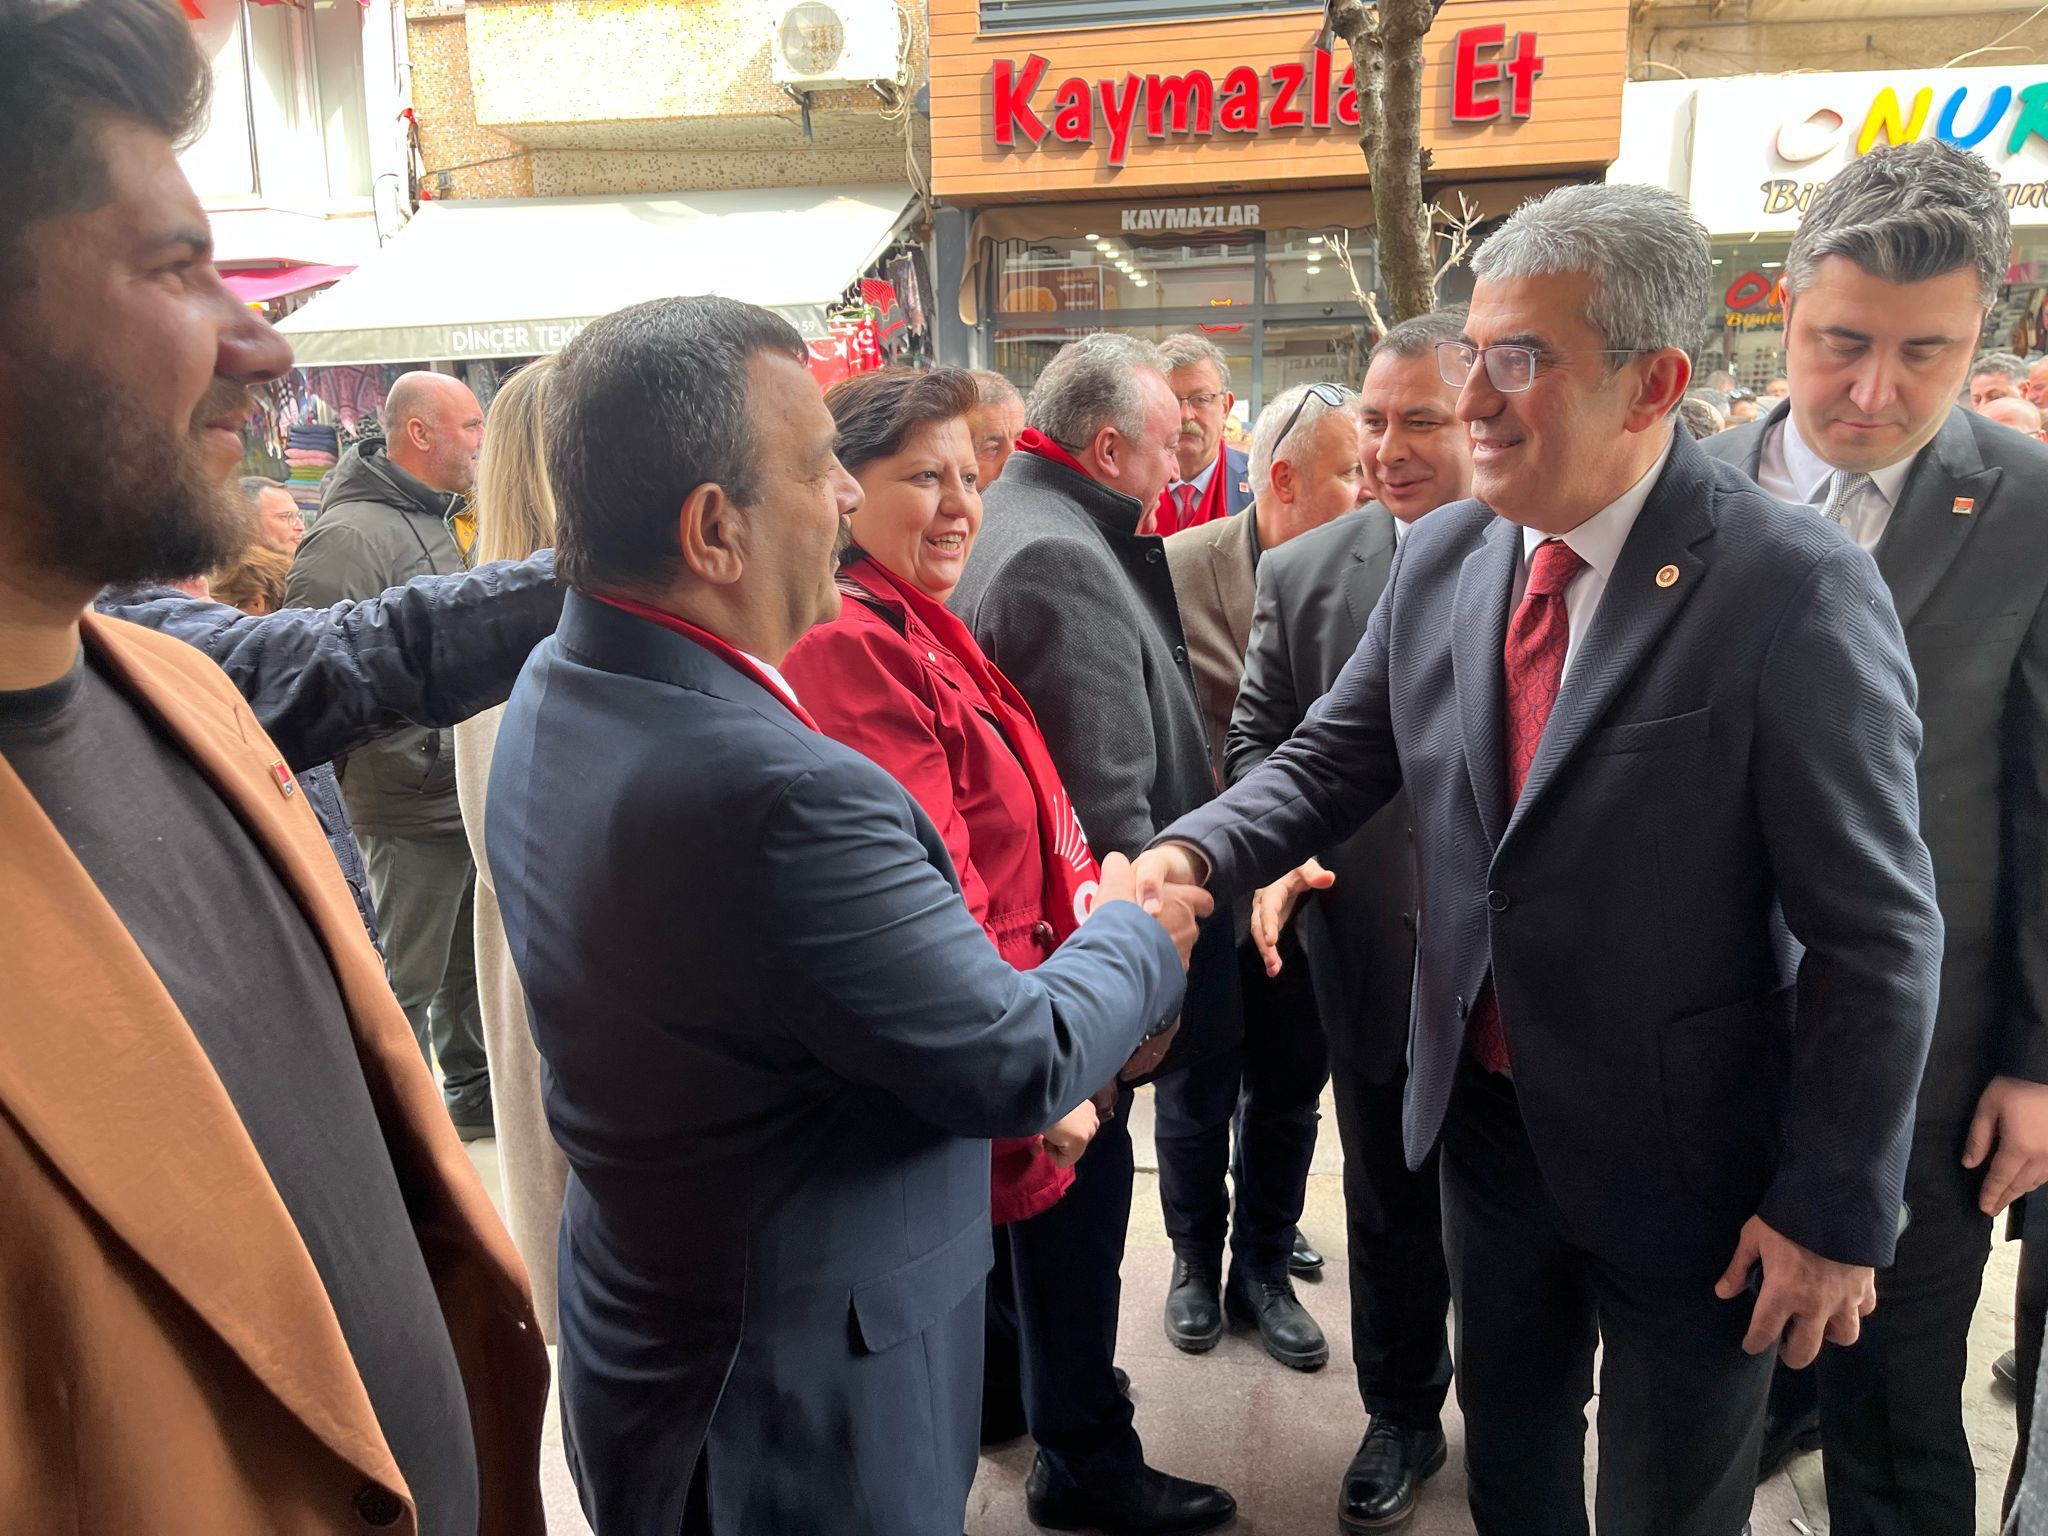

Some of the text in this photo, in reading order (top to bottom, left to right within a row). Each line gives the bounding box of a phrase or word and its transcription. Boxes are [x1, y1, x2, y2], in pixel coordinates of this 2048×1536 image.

[992, 24, 1544, 167] Kaymazla Et
[1121, 204, 1260, 230] KAYMAZLAR
[452, 325, 529, 352] DİNÇER
